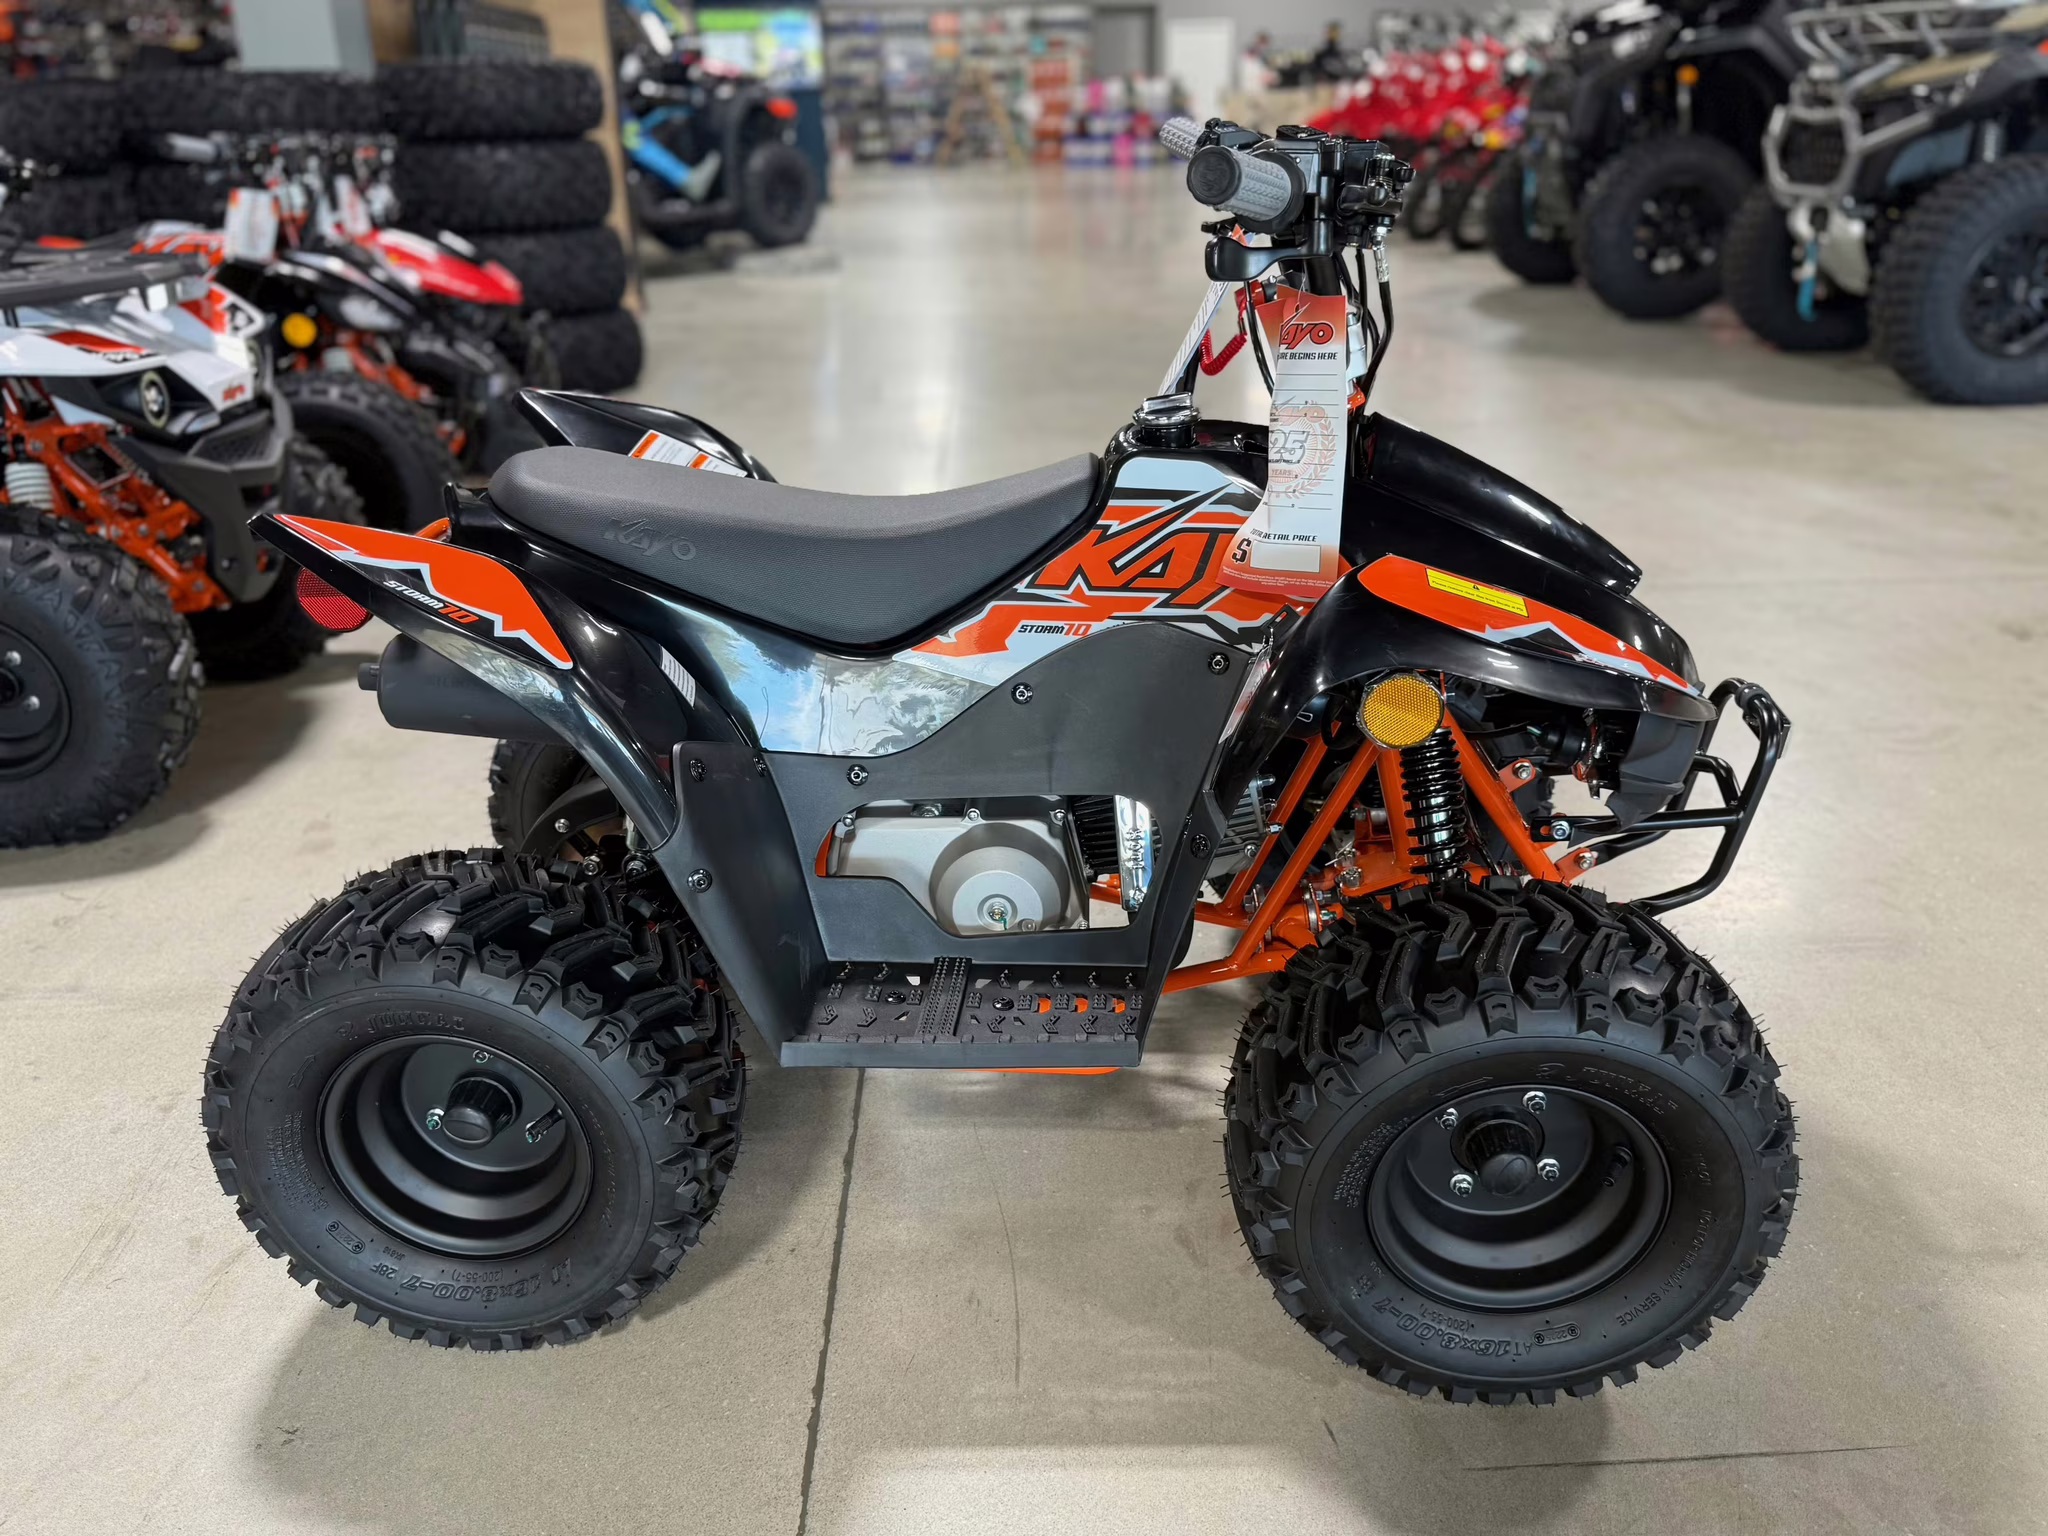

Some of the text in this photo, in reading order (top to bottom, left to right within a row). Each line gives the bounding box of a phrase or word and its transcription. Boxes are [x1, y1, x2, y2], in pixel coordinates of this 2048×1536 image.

[1289, 352, 1316, 360] BEGINS
[1317, 352, 1338, 360] HERE
[1262, 532, 1291, 541] RETAIL
[1292, 534, 1318, 542] PRICE
[1232, 537, 1251, 563] $
[369, 1262, 398, 1281] 28F
[451, 1267, 504, 1284] (200-55-7)
[1659, 1251, 1697, 1294] HIGHWAY
[1615, 1291, 1662, 1327] SERVICE
[1513, 1341, 1532, 1357] AT
